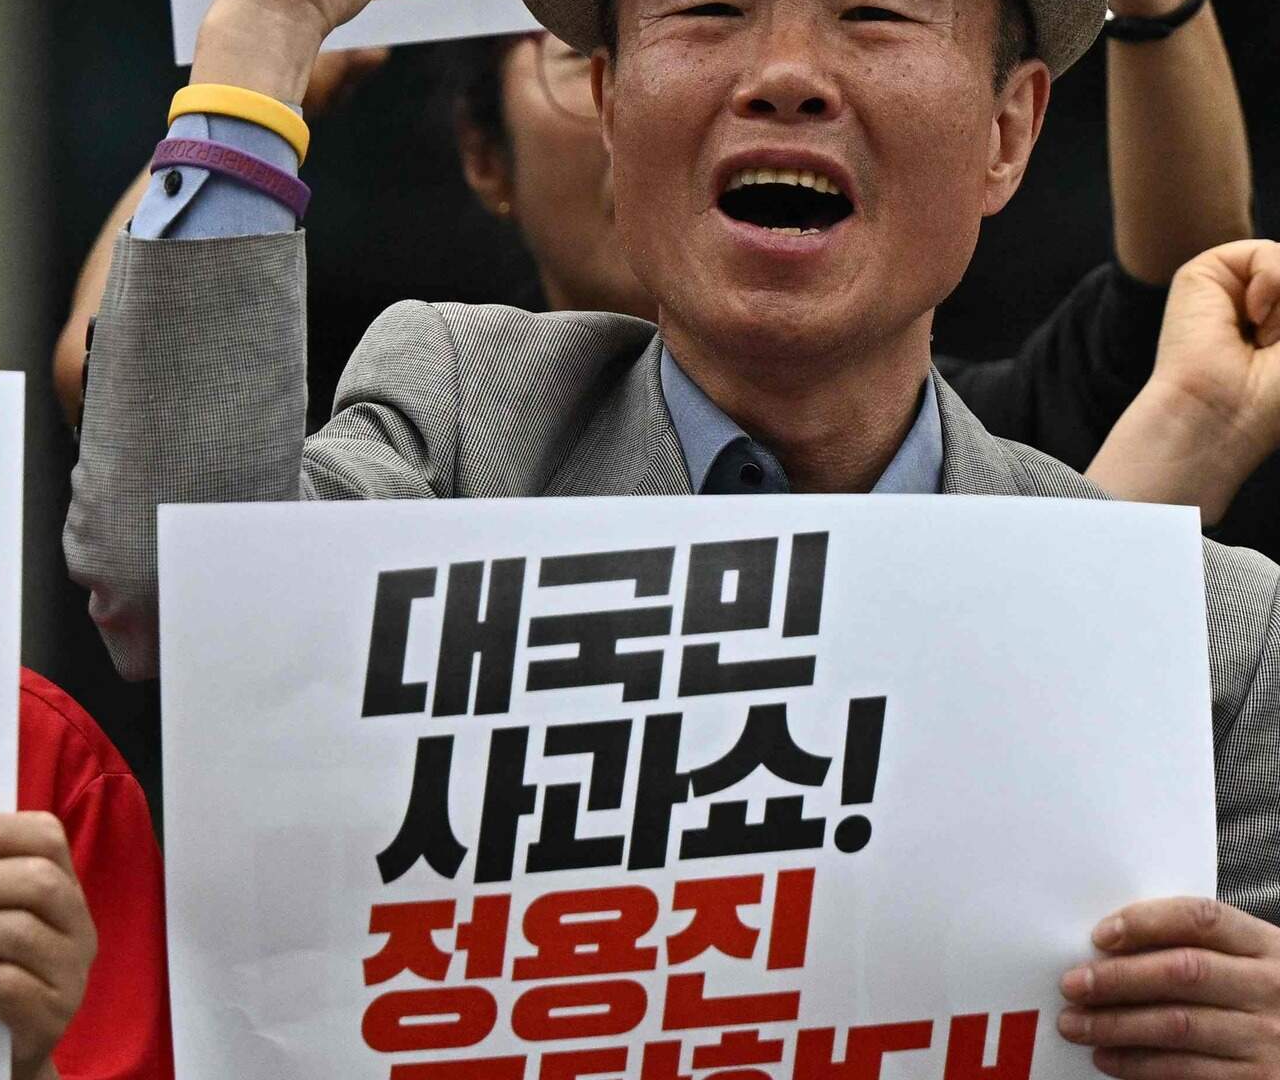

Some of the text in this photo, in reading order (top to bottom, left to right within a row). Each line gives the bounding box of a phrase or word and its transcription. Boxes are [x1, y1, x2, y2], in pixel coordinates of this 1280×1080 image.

[361, 529, 830, 718] 대국민
[376, 696, 886, 885] 사과쇼!
[360, 868, 816, 1052] 정용진
